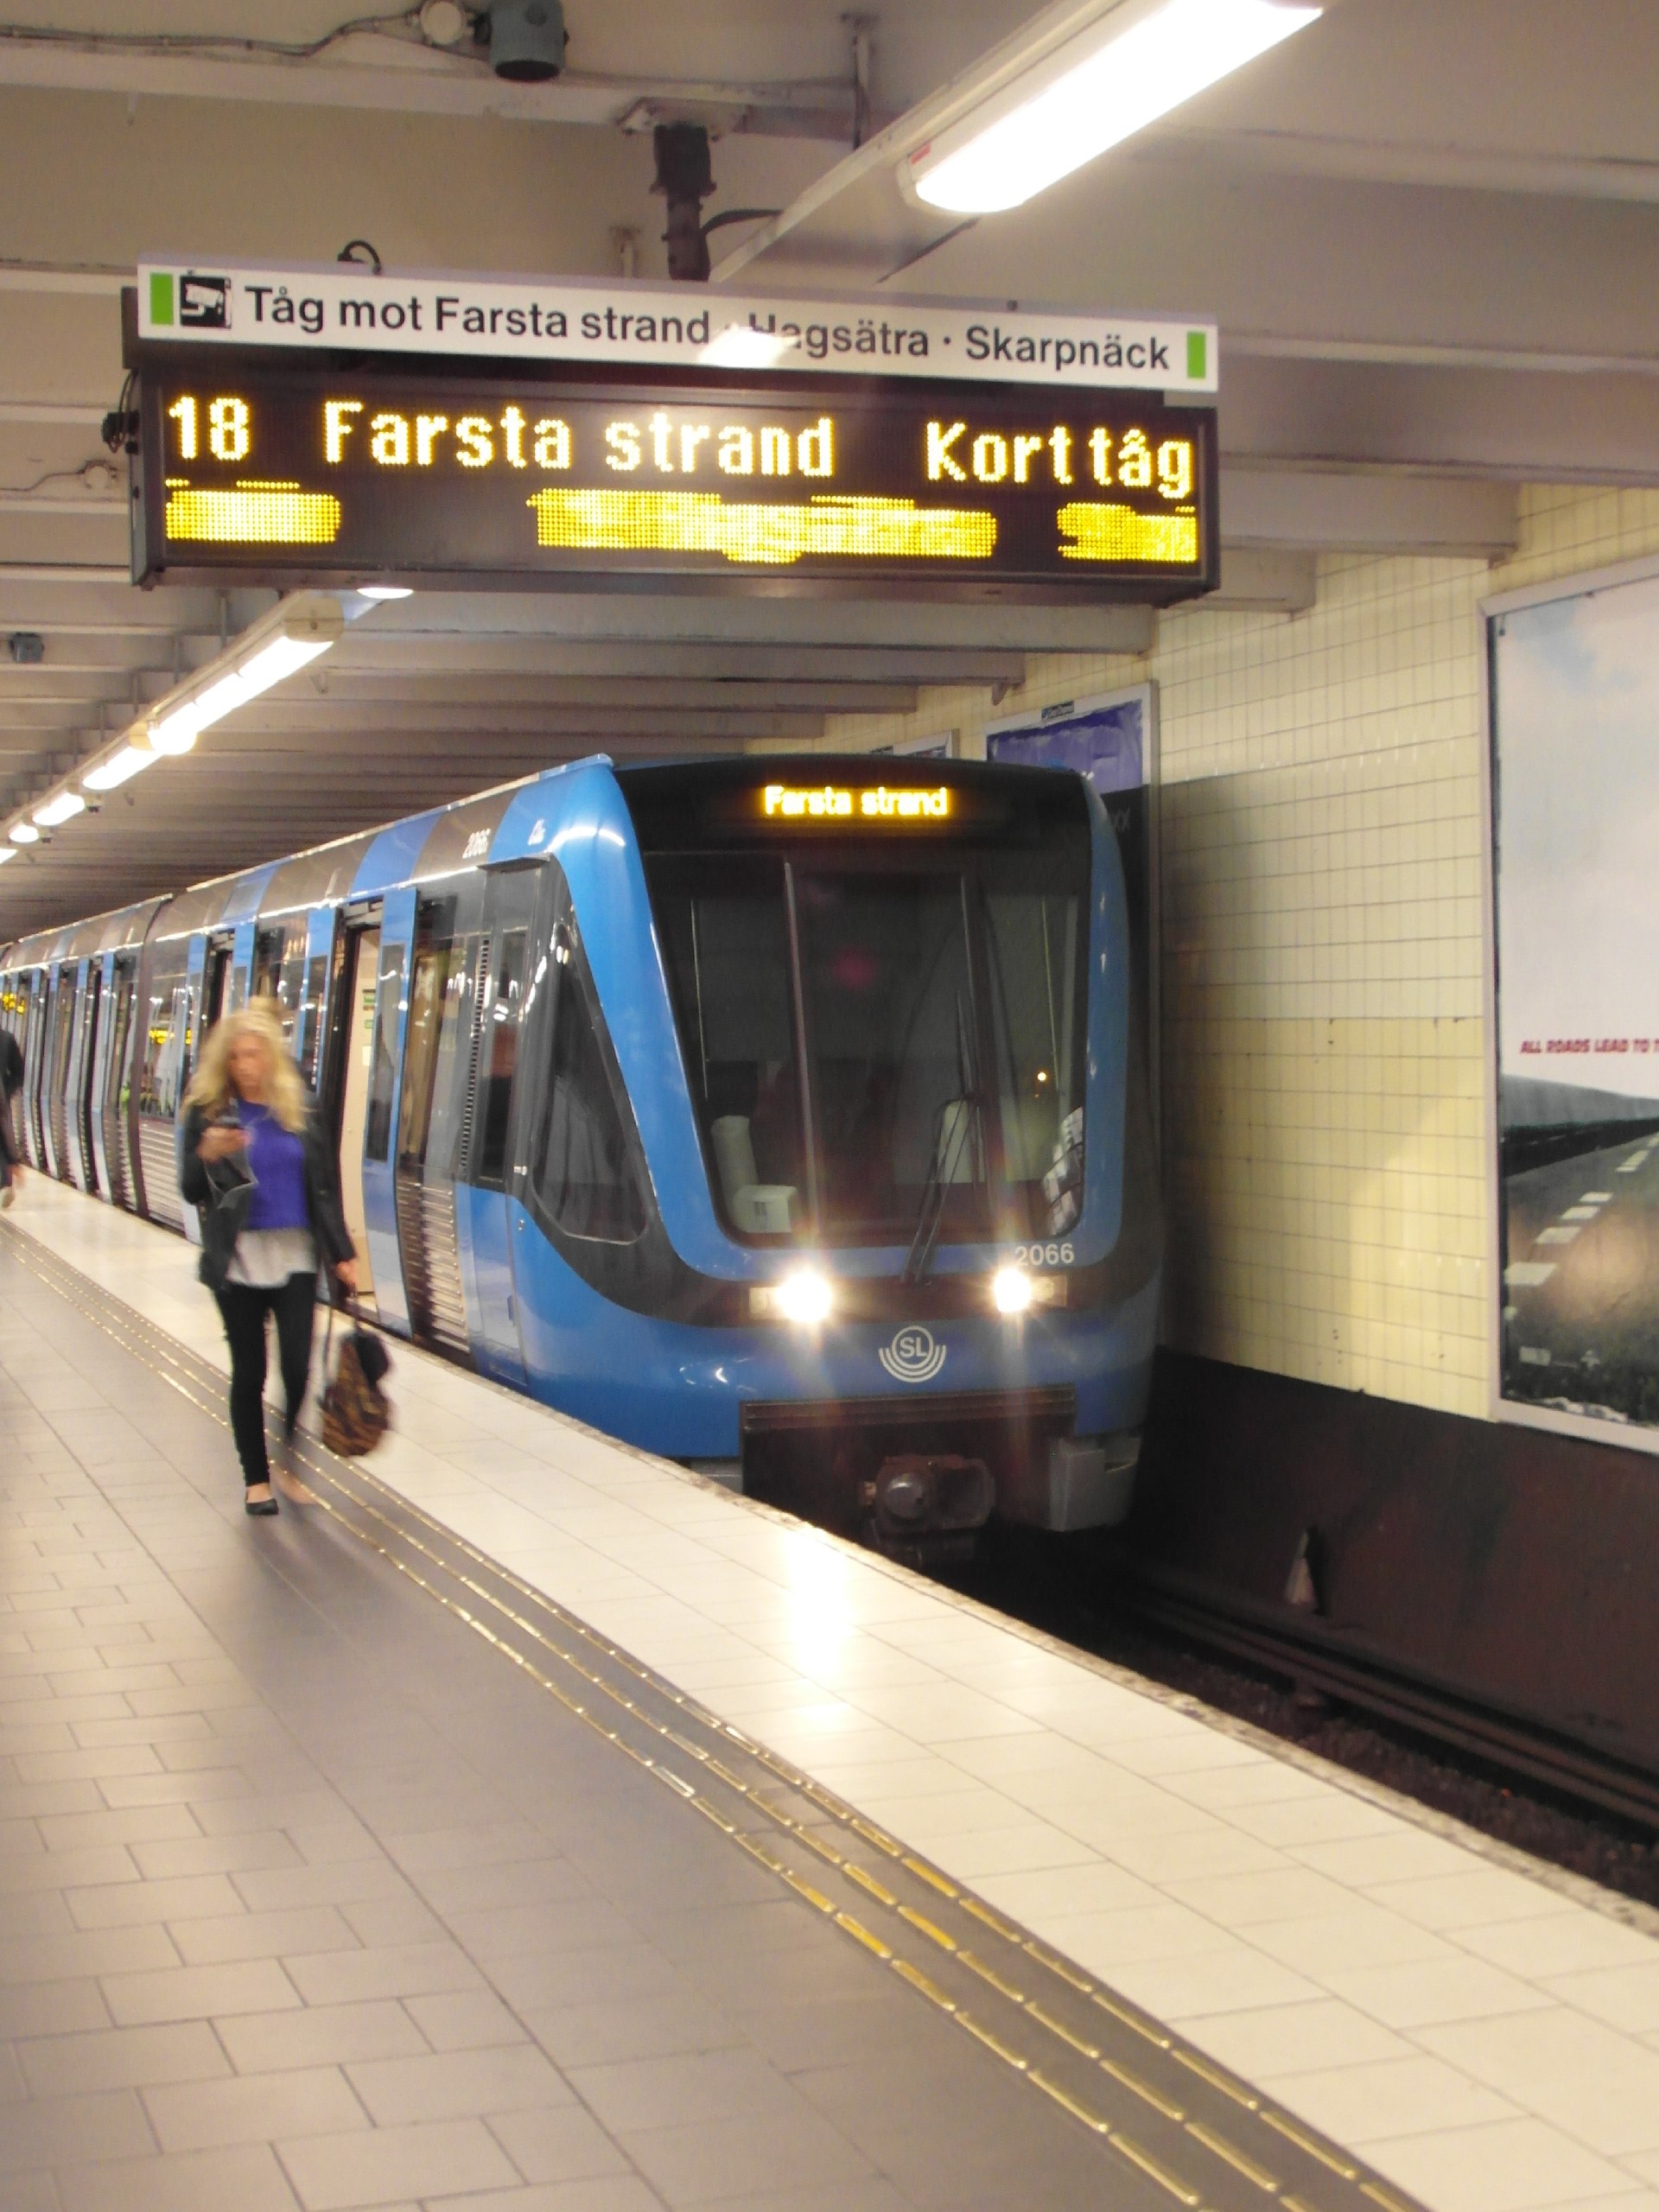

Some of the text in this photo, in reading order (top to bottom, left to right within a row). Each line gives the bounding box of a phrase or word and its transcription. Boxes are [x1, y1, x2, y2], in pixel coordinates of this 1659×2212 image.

[245, 283, 324, 334] Tåg
[340, 296, 423, 330] mot
[435, 296, 568, 338] Farsta
[581, 309, 709, 345] strand
[964, 324, 1170, 372] Skarpnäck
[168, 395, 1192, 499] 18 Farsta strand Kort tåg
[765, 785, 948, 816] Farsta strand
[1520, 1040, 1541, 1053] ALL
[1546, 1039, 1590, 1053] ROADS
[1595, 1039, 1629, 1052] LEAD
[1633, 1038, 1650, 1052] TO
[1014, 1243, 1075, 1266] 2066
[899, 1336, 927, 1358] SL
